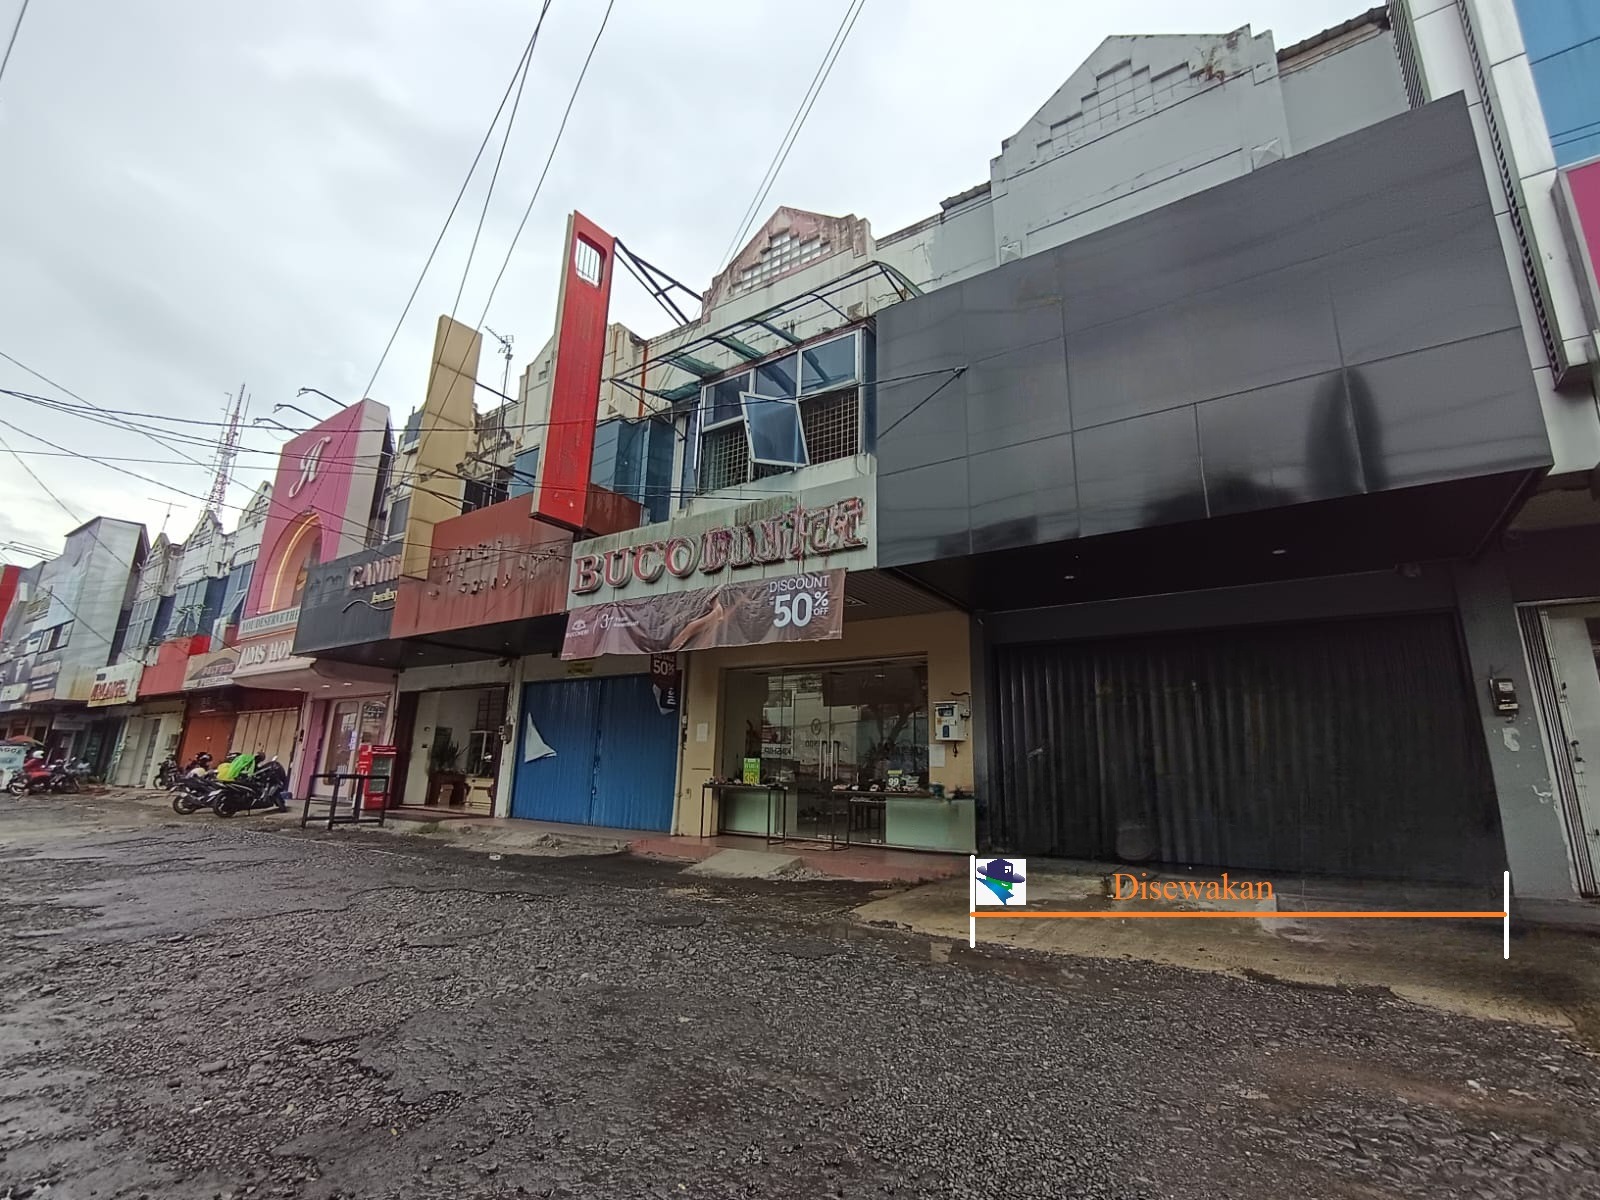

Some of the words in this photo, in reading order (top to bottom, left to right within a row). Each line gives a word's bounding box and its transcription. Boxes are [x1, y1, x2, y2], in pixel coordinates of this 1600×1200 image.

[769, 575, 830, 593] DISCOUNT
[773, 591, 829, 628] 50%
[813, 607, 829, 616] OFF
